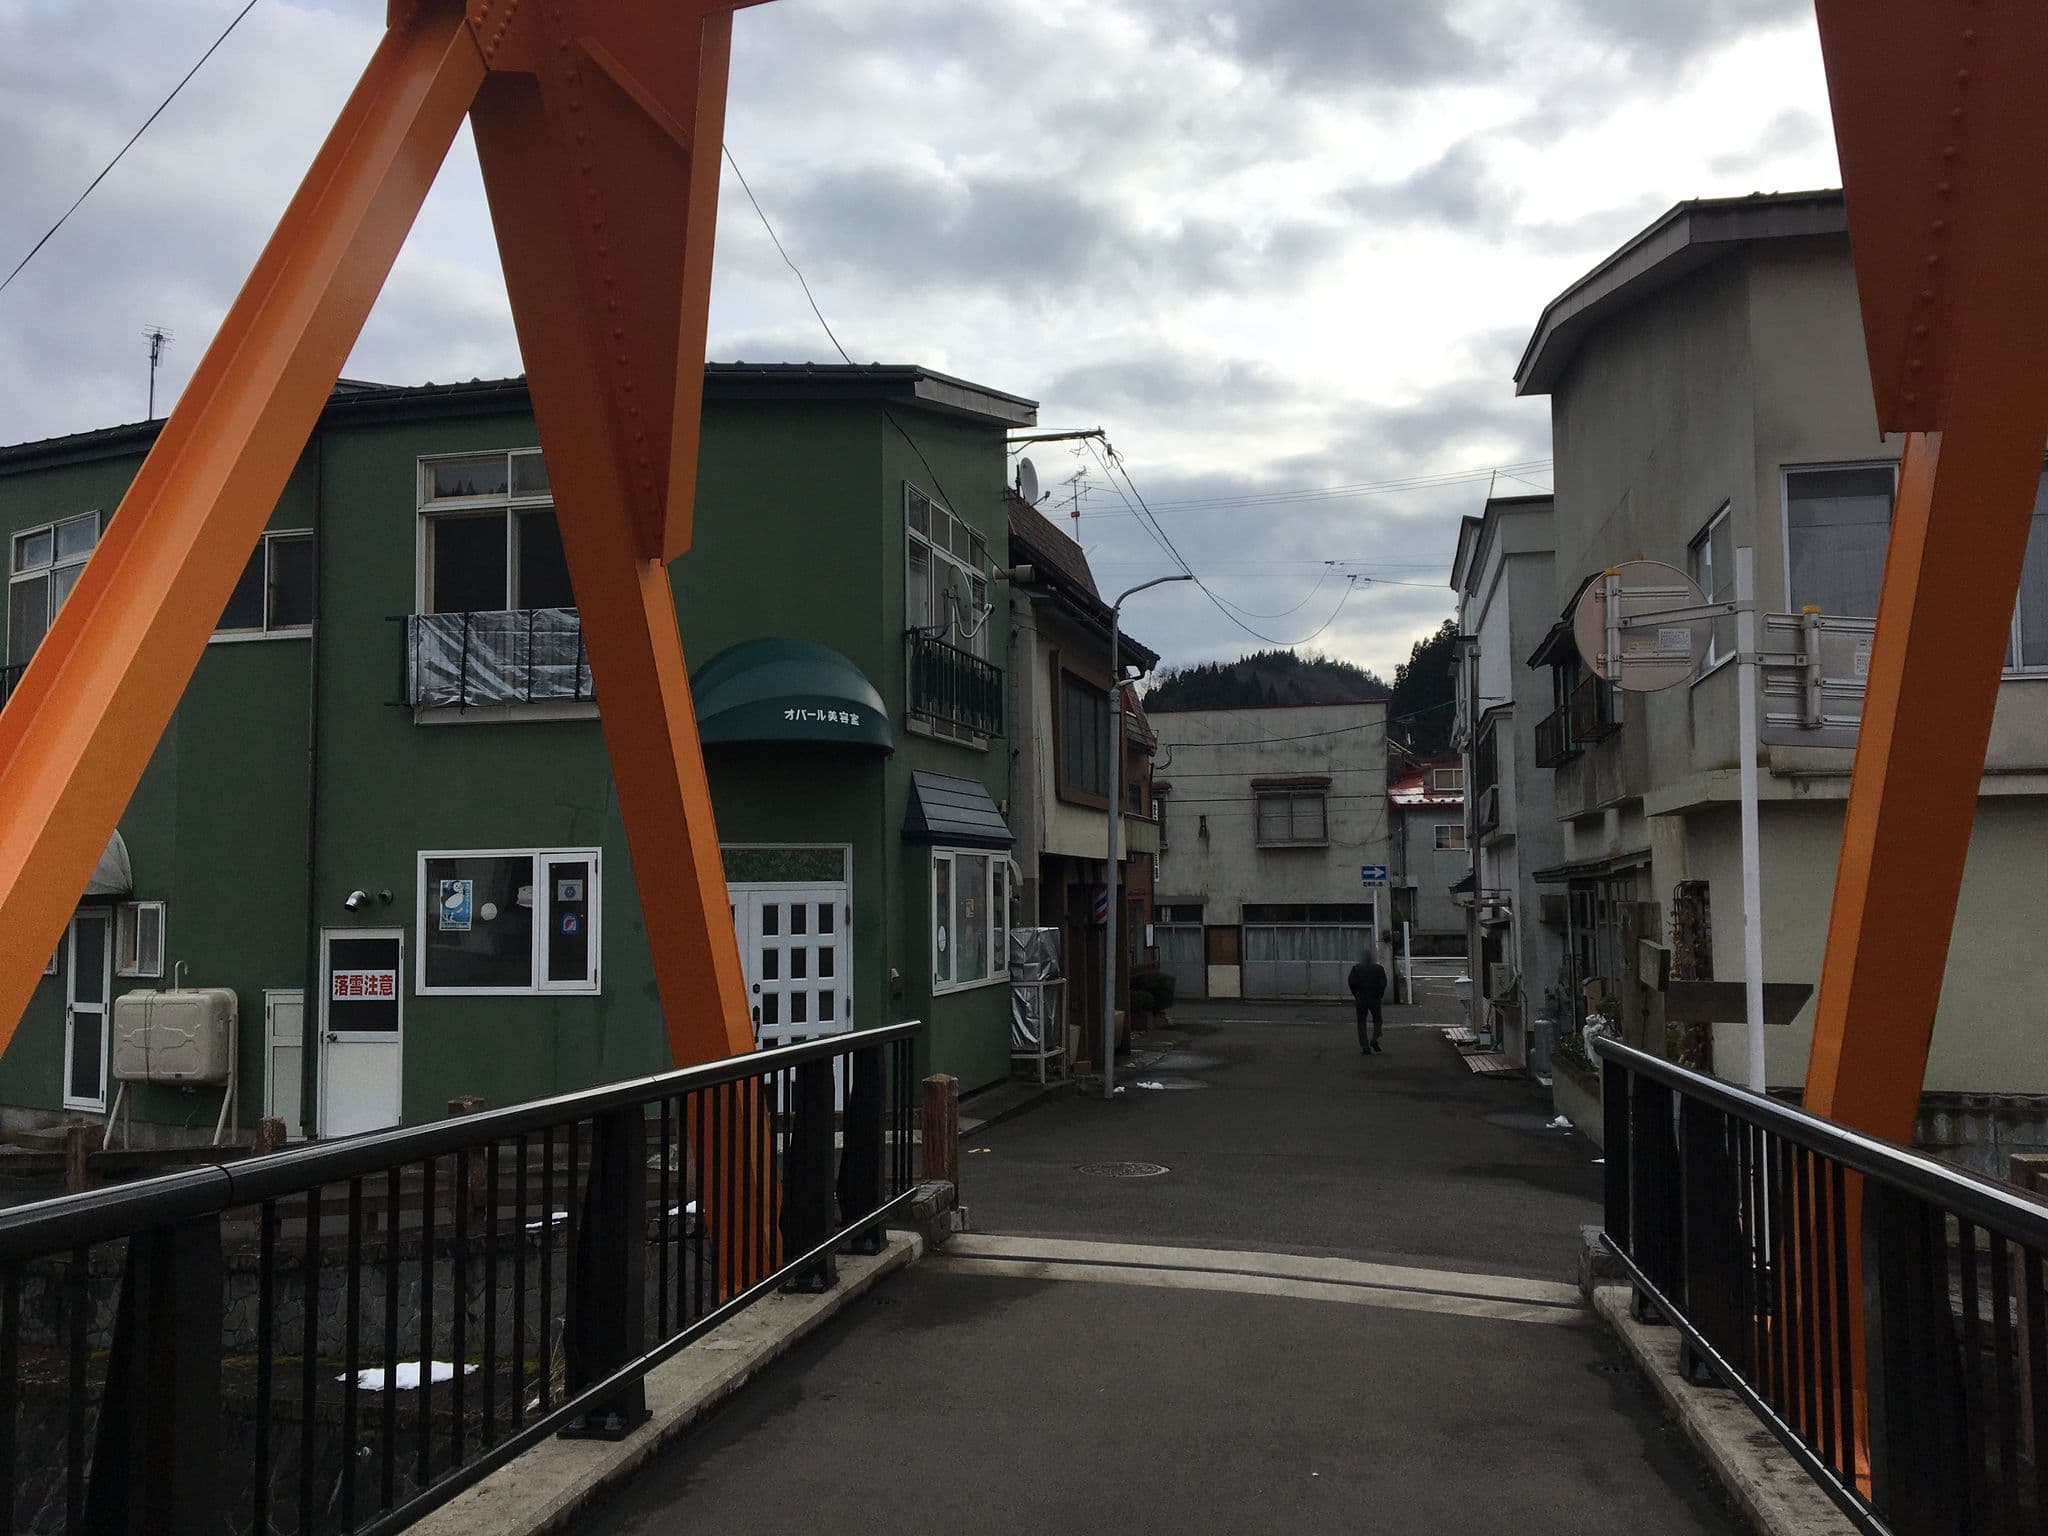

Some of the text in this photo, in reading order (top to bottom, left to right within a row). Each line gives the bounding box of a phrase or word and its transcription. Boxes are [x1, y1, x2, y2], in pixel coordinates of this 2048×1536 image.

[784, 708, 859, 726] オバール美容室
[335, 974, 393, 997] 落雪注意
